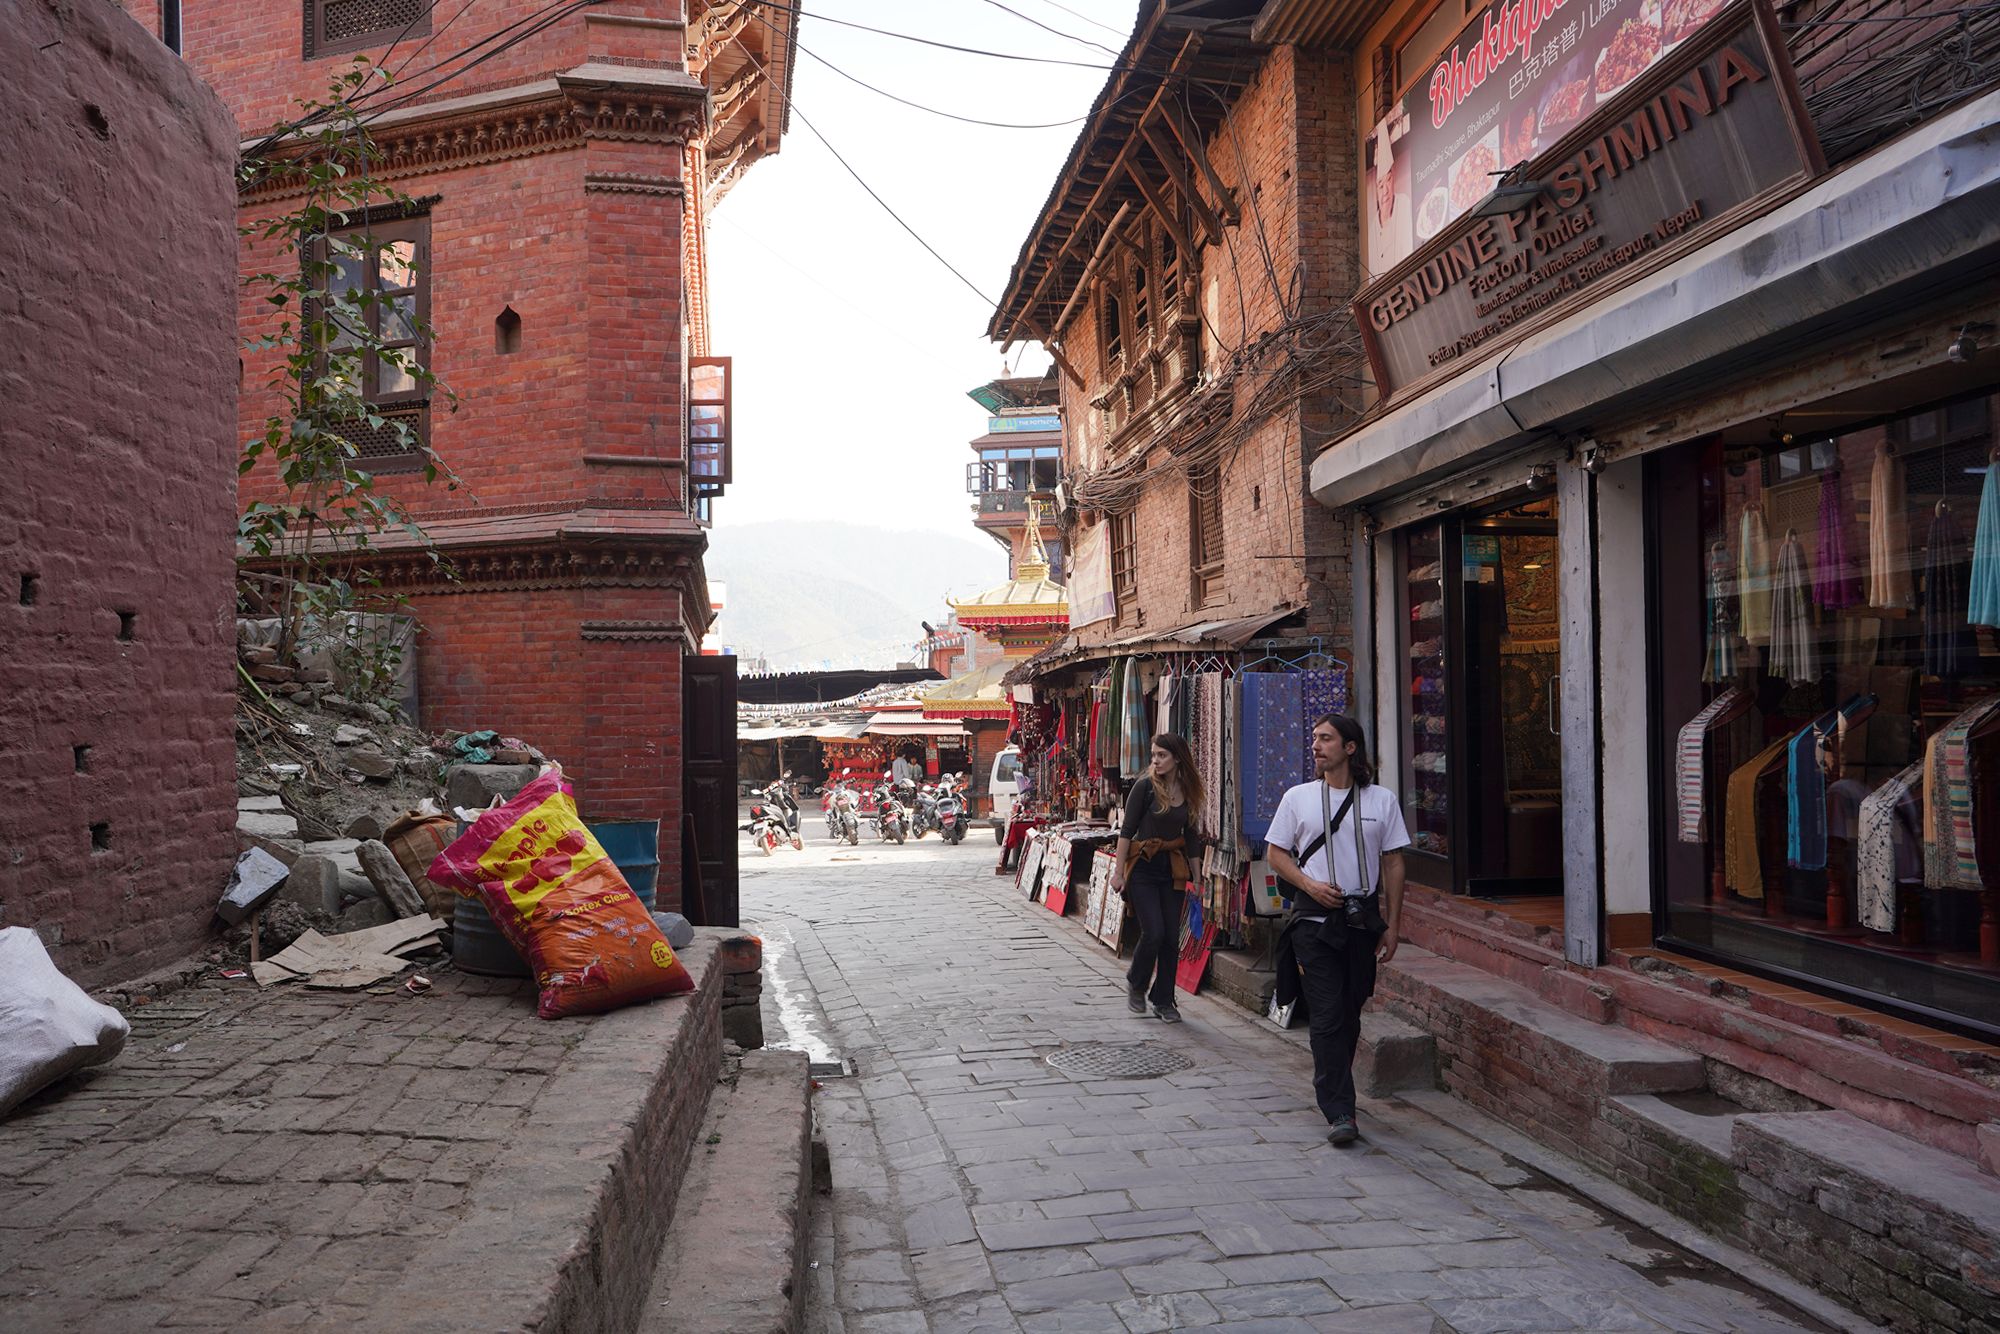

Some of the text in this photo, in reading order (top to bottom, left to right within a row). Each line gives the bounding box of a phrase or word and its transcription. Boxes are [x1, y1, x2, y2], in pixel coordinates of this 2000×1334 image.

[1467, 101, 1500, 138] Bhaktapur
[1368, 45, 1767, 332] GENUINE PASHMINA
[1468, 204, 1594, 297] Factory Outlet
[1531, 272, 1541, 284] &
[1540, 237, 1600, 277] Wholeseller
[1578, 237, 1653, 282] Bhaktapur,
[1654, 201, 1701, 241] Nepal
[564, 892, 631, 916] Sortex Clean
